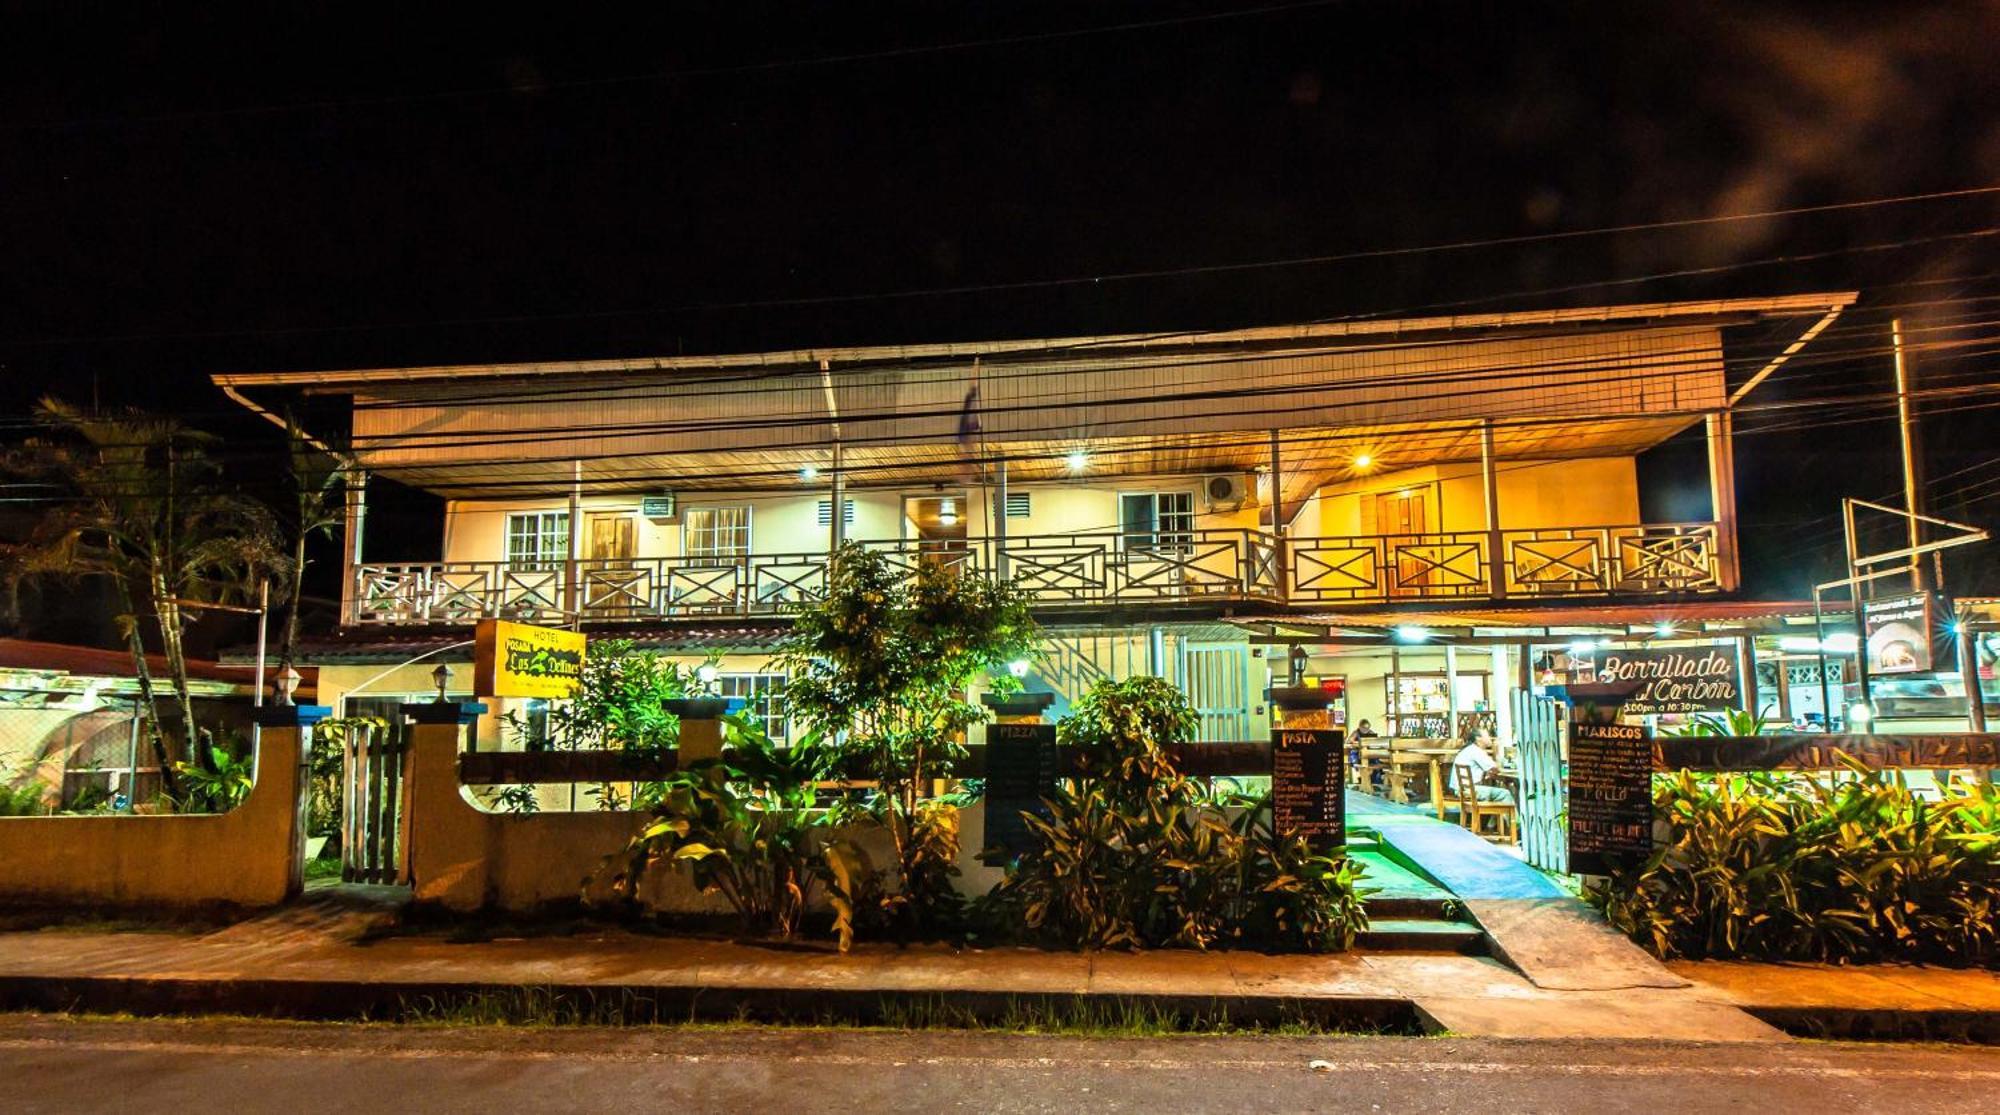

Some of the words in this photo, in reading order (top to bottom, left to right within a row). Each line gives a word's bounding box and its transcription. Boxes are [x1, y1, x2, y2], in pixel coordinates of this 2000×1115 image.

[534, 631, 559, 643] HOTEL
[510, 652, 529, 670] Los
[1000, 726, 1038, 738] PIZZA
[1578, 726, 1642, 739] MARISCOS
[1282, 732, 1317, 748] PASTA
